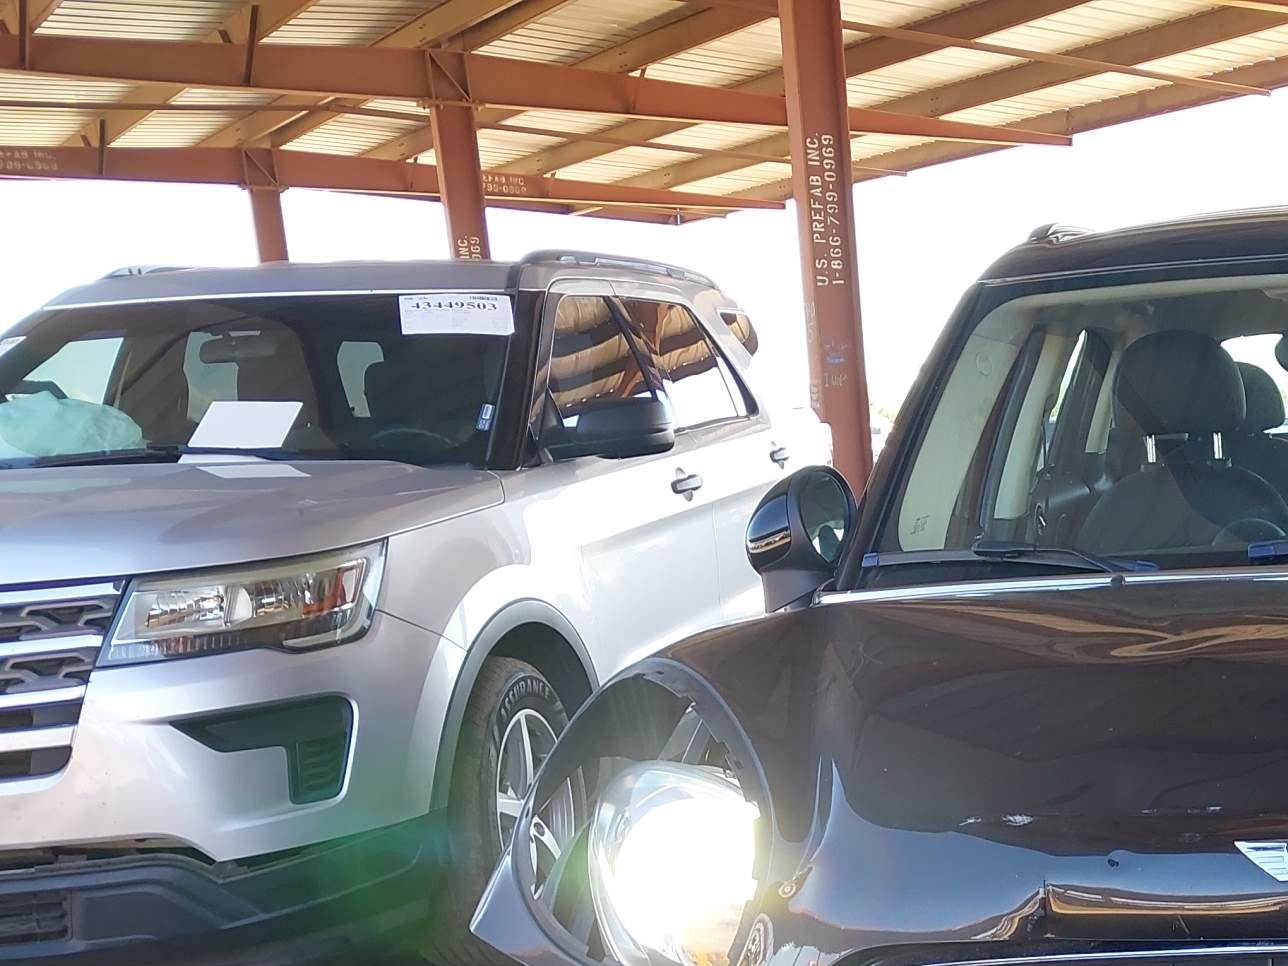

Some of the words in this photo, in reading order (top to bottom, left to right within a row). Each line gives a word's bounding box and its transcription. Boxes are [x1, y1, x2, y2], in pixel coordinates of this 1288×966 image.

[806, 132, 821, 166] INC.
[809, 175, 827, 243] PREFAB
[821, 134, 845, 285] 1-866-799-0969
[815, 254, 829, 287] U.S.
